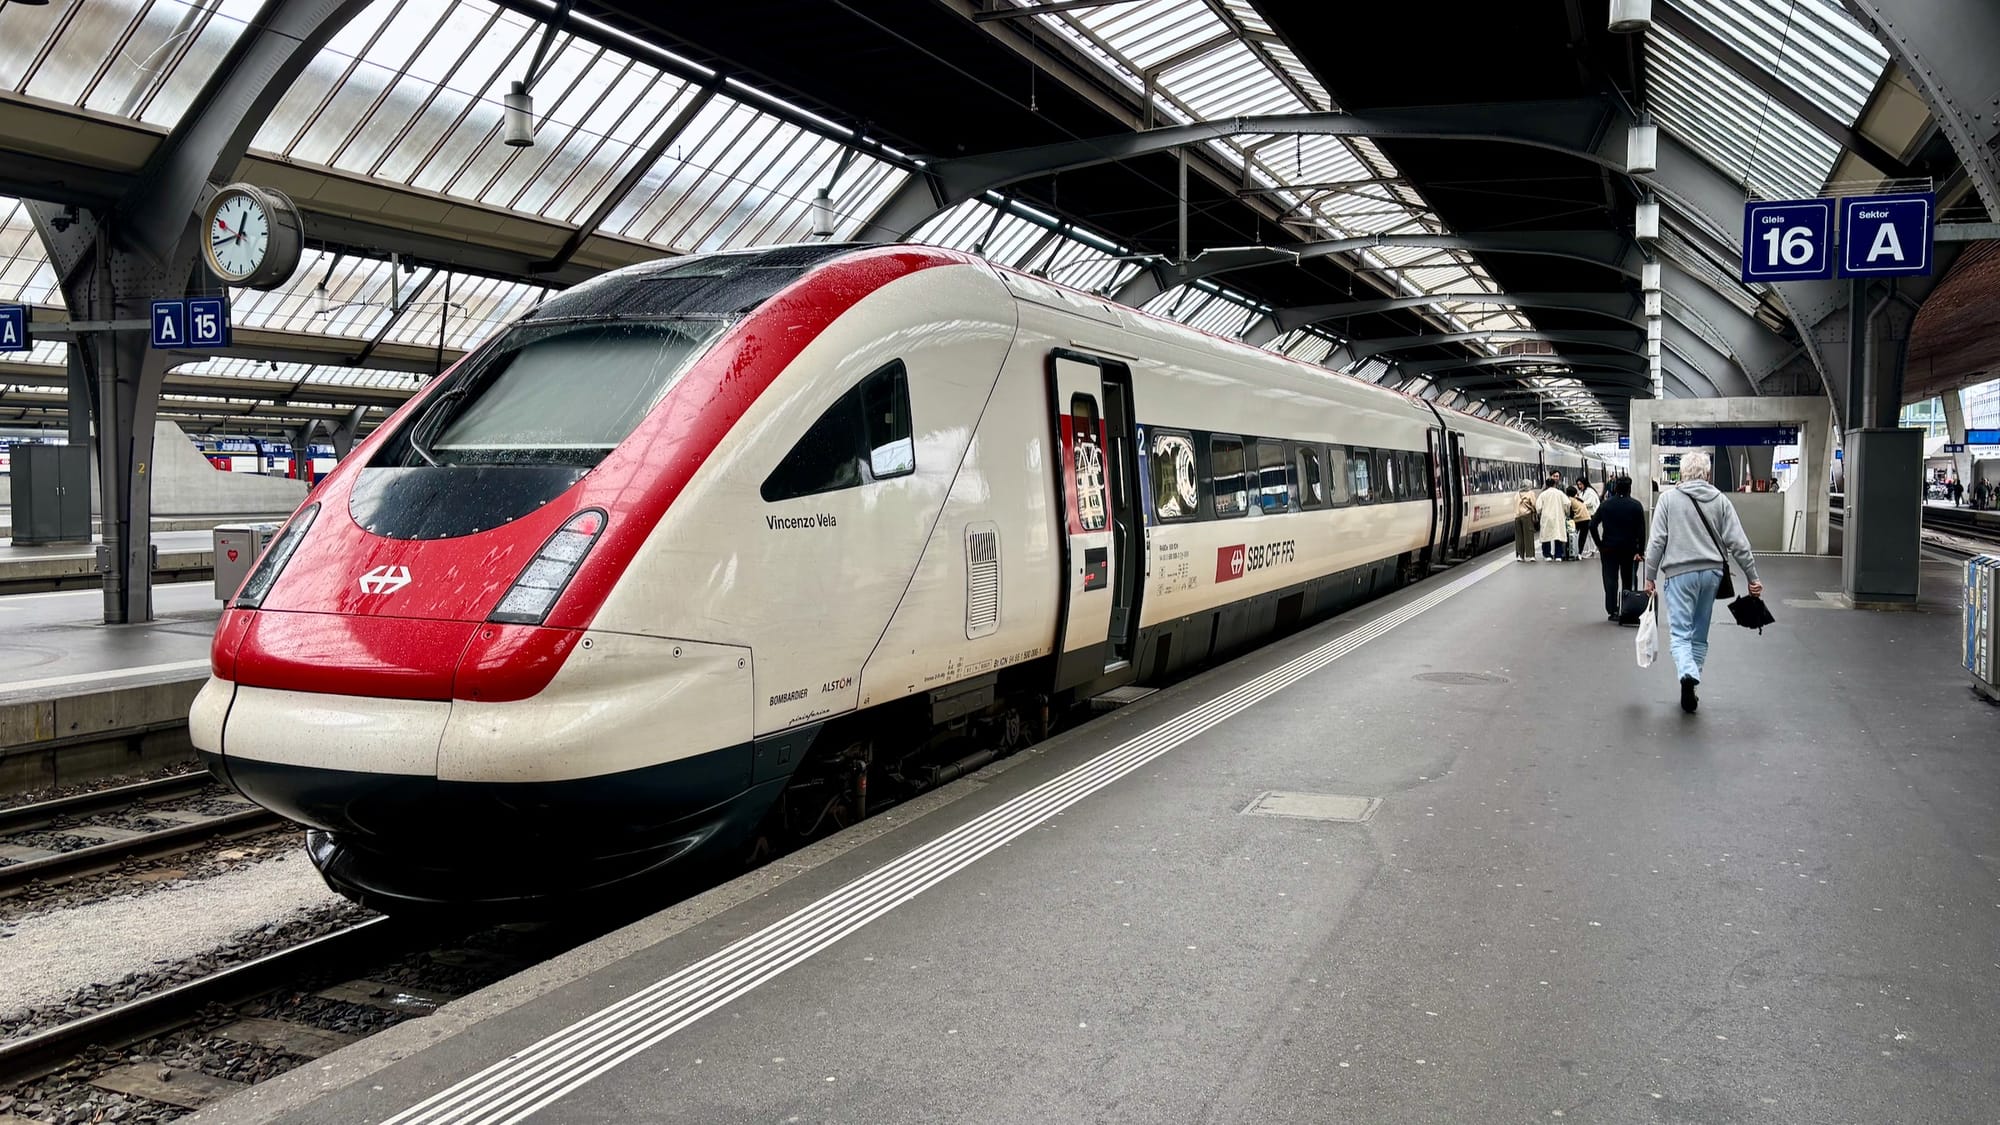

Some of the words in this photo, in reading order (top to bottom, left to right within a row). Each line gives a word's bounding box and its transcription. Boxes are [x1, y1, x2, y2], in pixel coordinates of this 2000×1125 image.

[1761, 215, 1785, 224] Gleis
[1858, 209, 1890, 220] Sektor
[1762, 226, 1814, 266] 16
[1866, 222, 1905, 262] A
[2, 320, 17, 344] A
[161, 315, 176, 340] A
[194, 314, 216, 339] 15
[1137, 427, 1146, 456] 2
[137, 462, 145, 473] 2
[766, 515, 815, 530] Vincenzo
[816, 513, 837, 527] Vela
[1247, 545, 1264, 571] SBB
[1265, 542, 1281, 568] CFF
[1282, 539, 1295, 563] FFS
[769, 688, 808, 706] BOMBARDIER
[821, 677, 852, 693] ALSTOM
